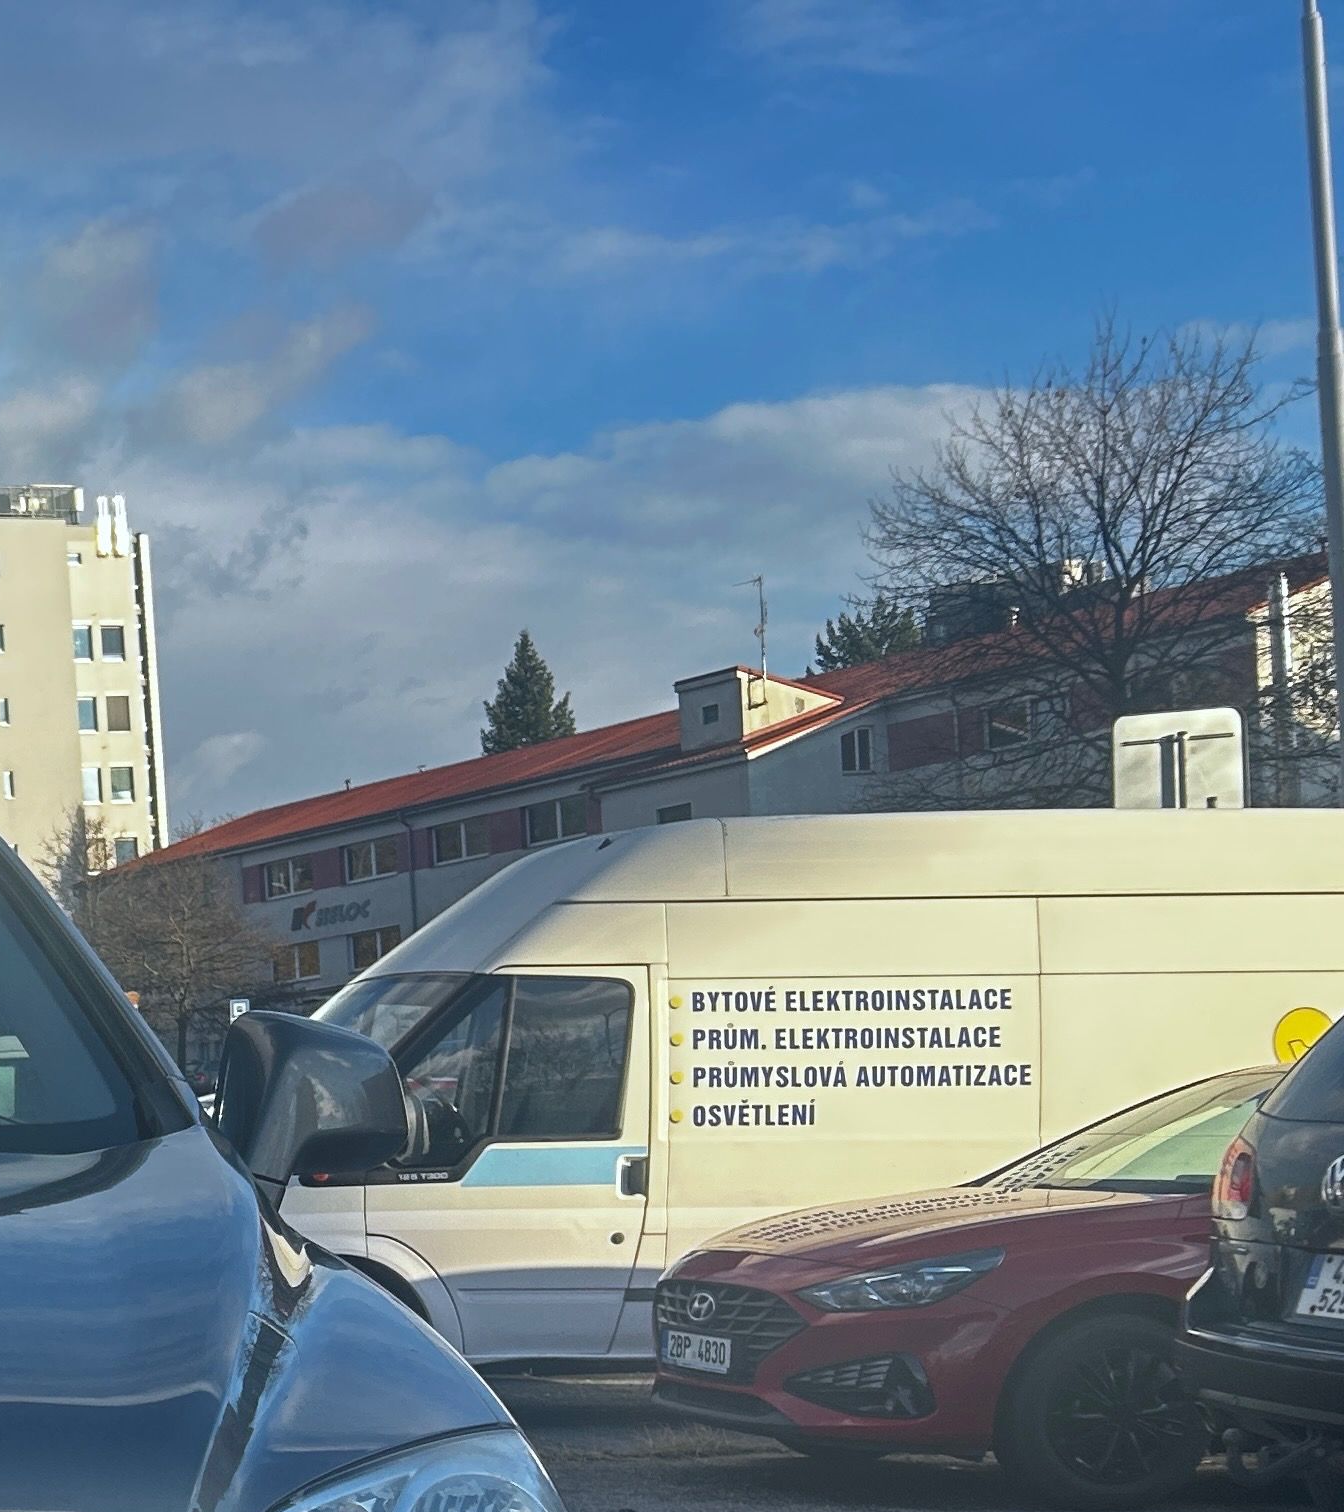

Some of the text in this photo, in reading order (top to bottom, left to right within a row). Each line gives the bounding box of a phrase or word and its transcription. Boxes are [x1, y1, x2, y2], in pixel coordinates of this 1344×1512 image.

[692, 985, 1012, 1012] BYTOVÉ ELEKTROINSTALACE
[692, 1022, 1002, 1050] PRŮM. ELEKTROINSTALACE
[693, 1060, 1032, 1088] PRŮMYSLOVÁ AUTOMATIZACE
[693, 1099, 815, 1127] OSVĚTLENÍ
[670, 1334, 726, 1365] 2BP 4830
